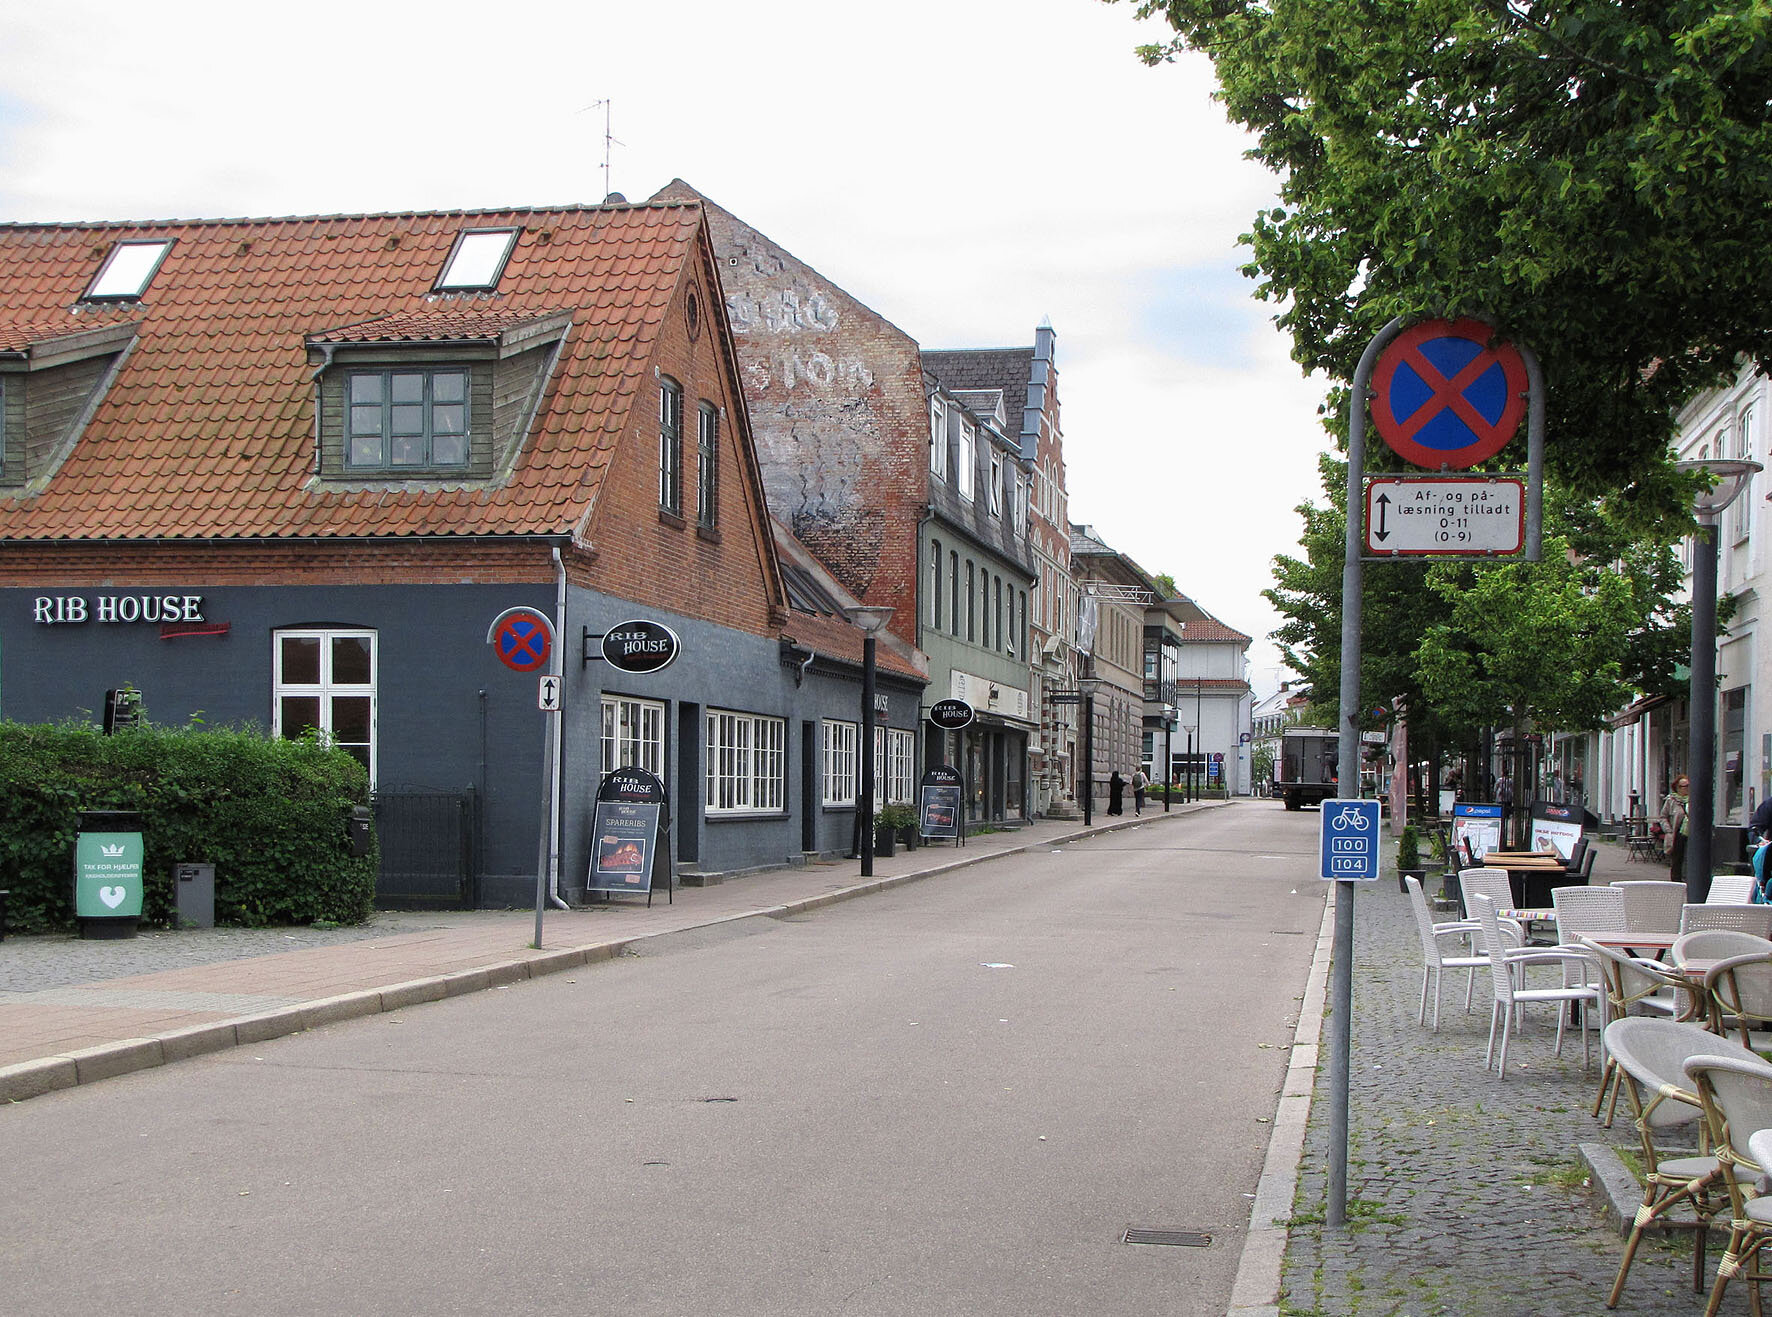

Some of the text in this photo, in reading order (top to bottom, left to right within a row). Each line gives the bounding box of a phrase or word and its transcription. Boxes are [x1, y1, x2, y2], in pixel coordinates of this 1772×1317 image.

[1415, 490, 1494, 503] Af- og på-
[1398, 504, 1510, 516] læsning tilladt
[1440, 518, 1468, 528] 0-11
[1435, 531, 1472, 542] (0-9)
[33, 596, 205, 624] RIB HOUSE
[609, 632, 647, 642] RIB
[623, 639, 668, 655] HOUSE
[942, 709, 969, 719] HOUSE
[612, 776, 639, 784] RIB
[620, 784, 652, 793] HOUSE
[605, 818, 646, 828] SPARERIBS
[1337, 840, 1363, 851] 100
[1336, 859, 1362, 870] 104
